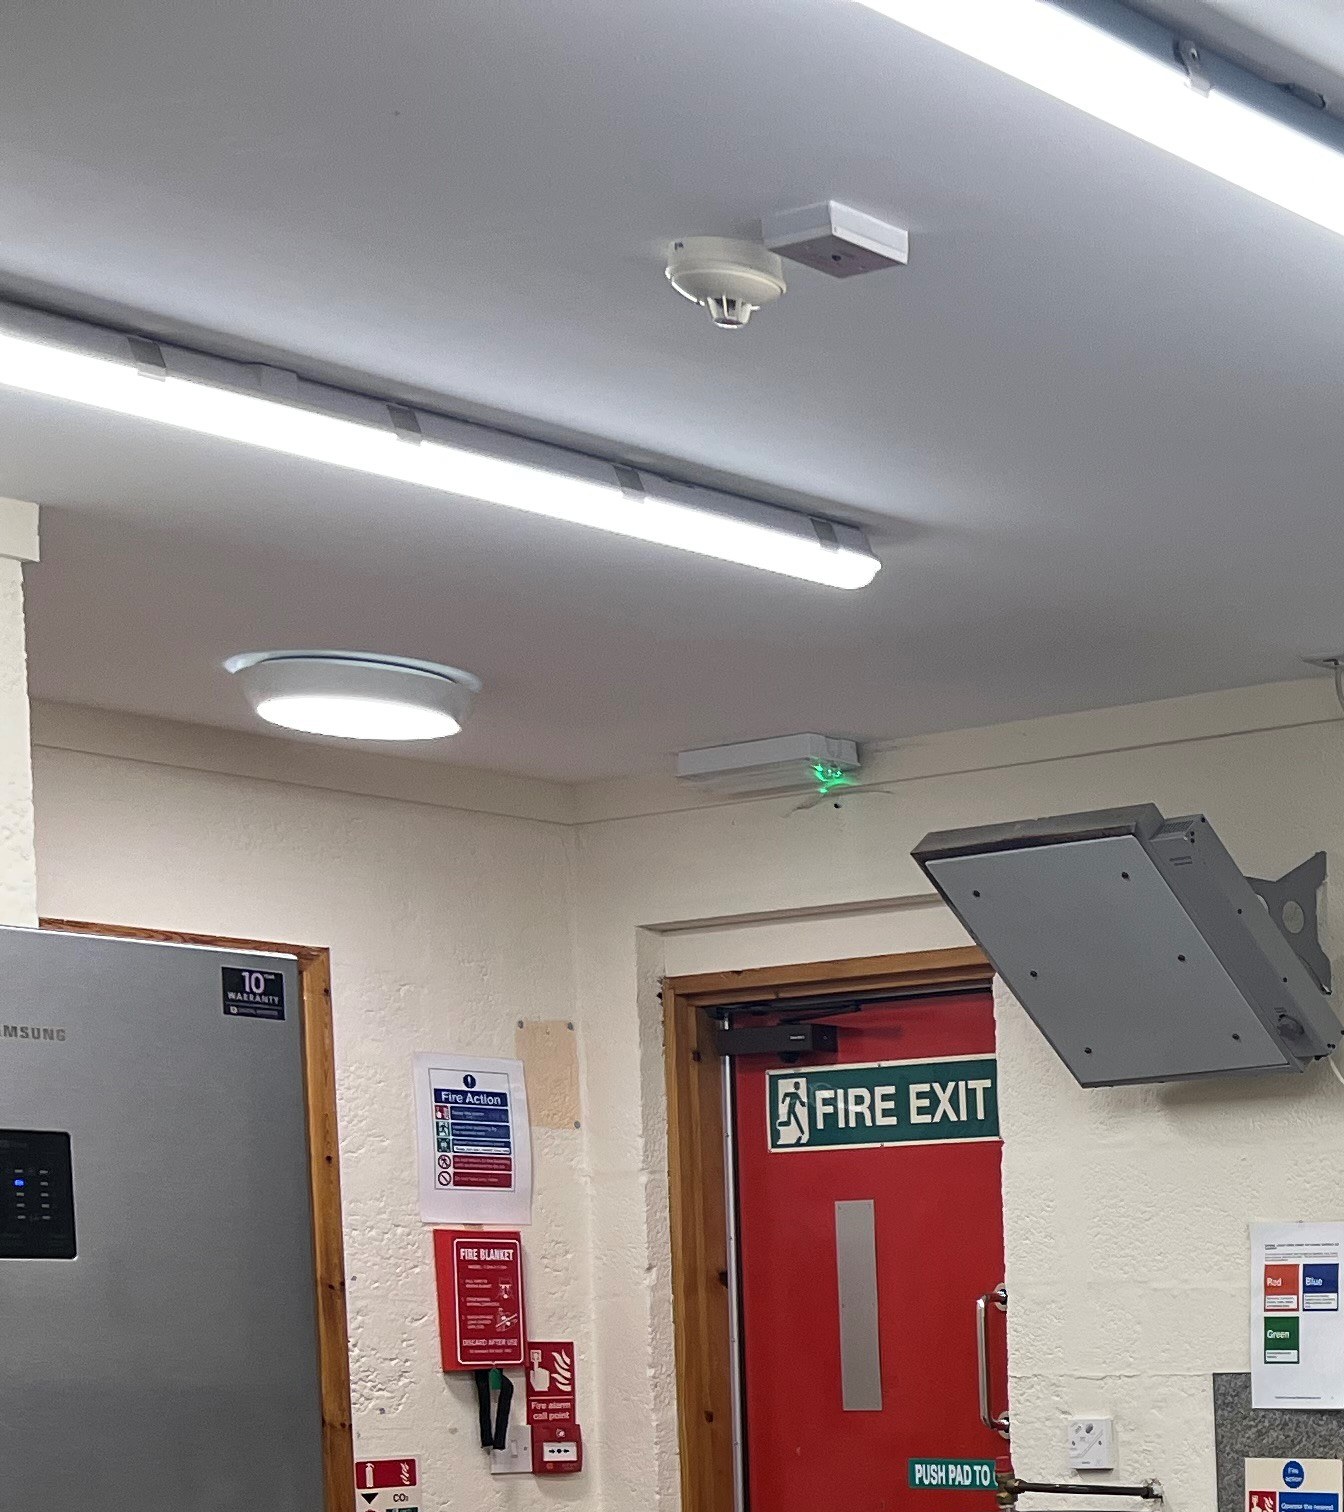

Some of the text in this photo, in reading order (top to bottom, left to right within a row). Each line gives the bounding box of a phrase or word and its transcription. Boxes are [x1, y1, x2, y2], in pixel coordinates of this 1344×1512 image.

[242, 972, 265, 994] 10
[227, 991, 279, 1004] WARRANTY
[0, 1025, 66, 1042] MSUNG
[441, 1091, 502, 1106] Fire Action
[814, 1078, 992, 1130] FIRE EXIT
[460, 1249, 514, 1260] FIRE BLANKET
[1266, 1277, 1282, 1287] Red
[1305, 1276, 1323, 1286] Blue
[1266, 1329, 1290, 1340] Green
[531, 1401, 571, 1410] Fire alarm
[532, 1411, 570, 1421] call point
[914, 1464, 946, 1485] PUSH
[948, 1464, 972, 1486] PAD
[973, 1464, 991, 1487] TO
